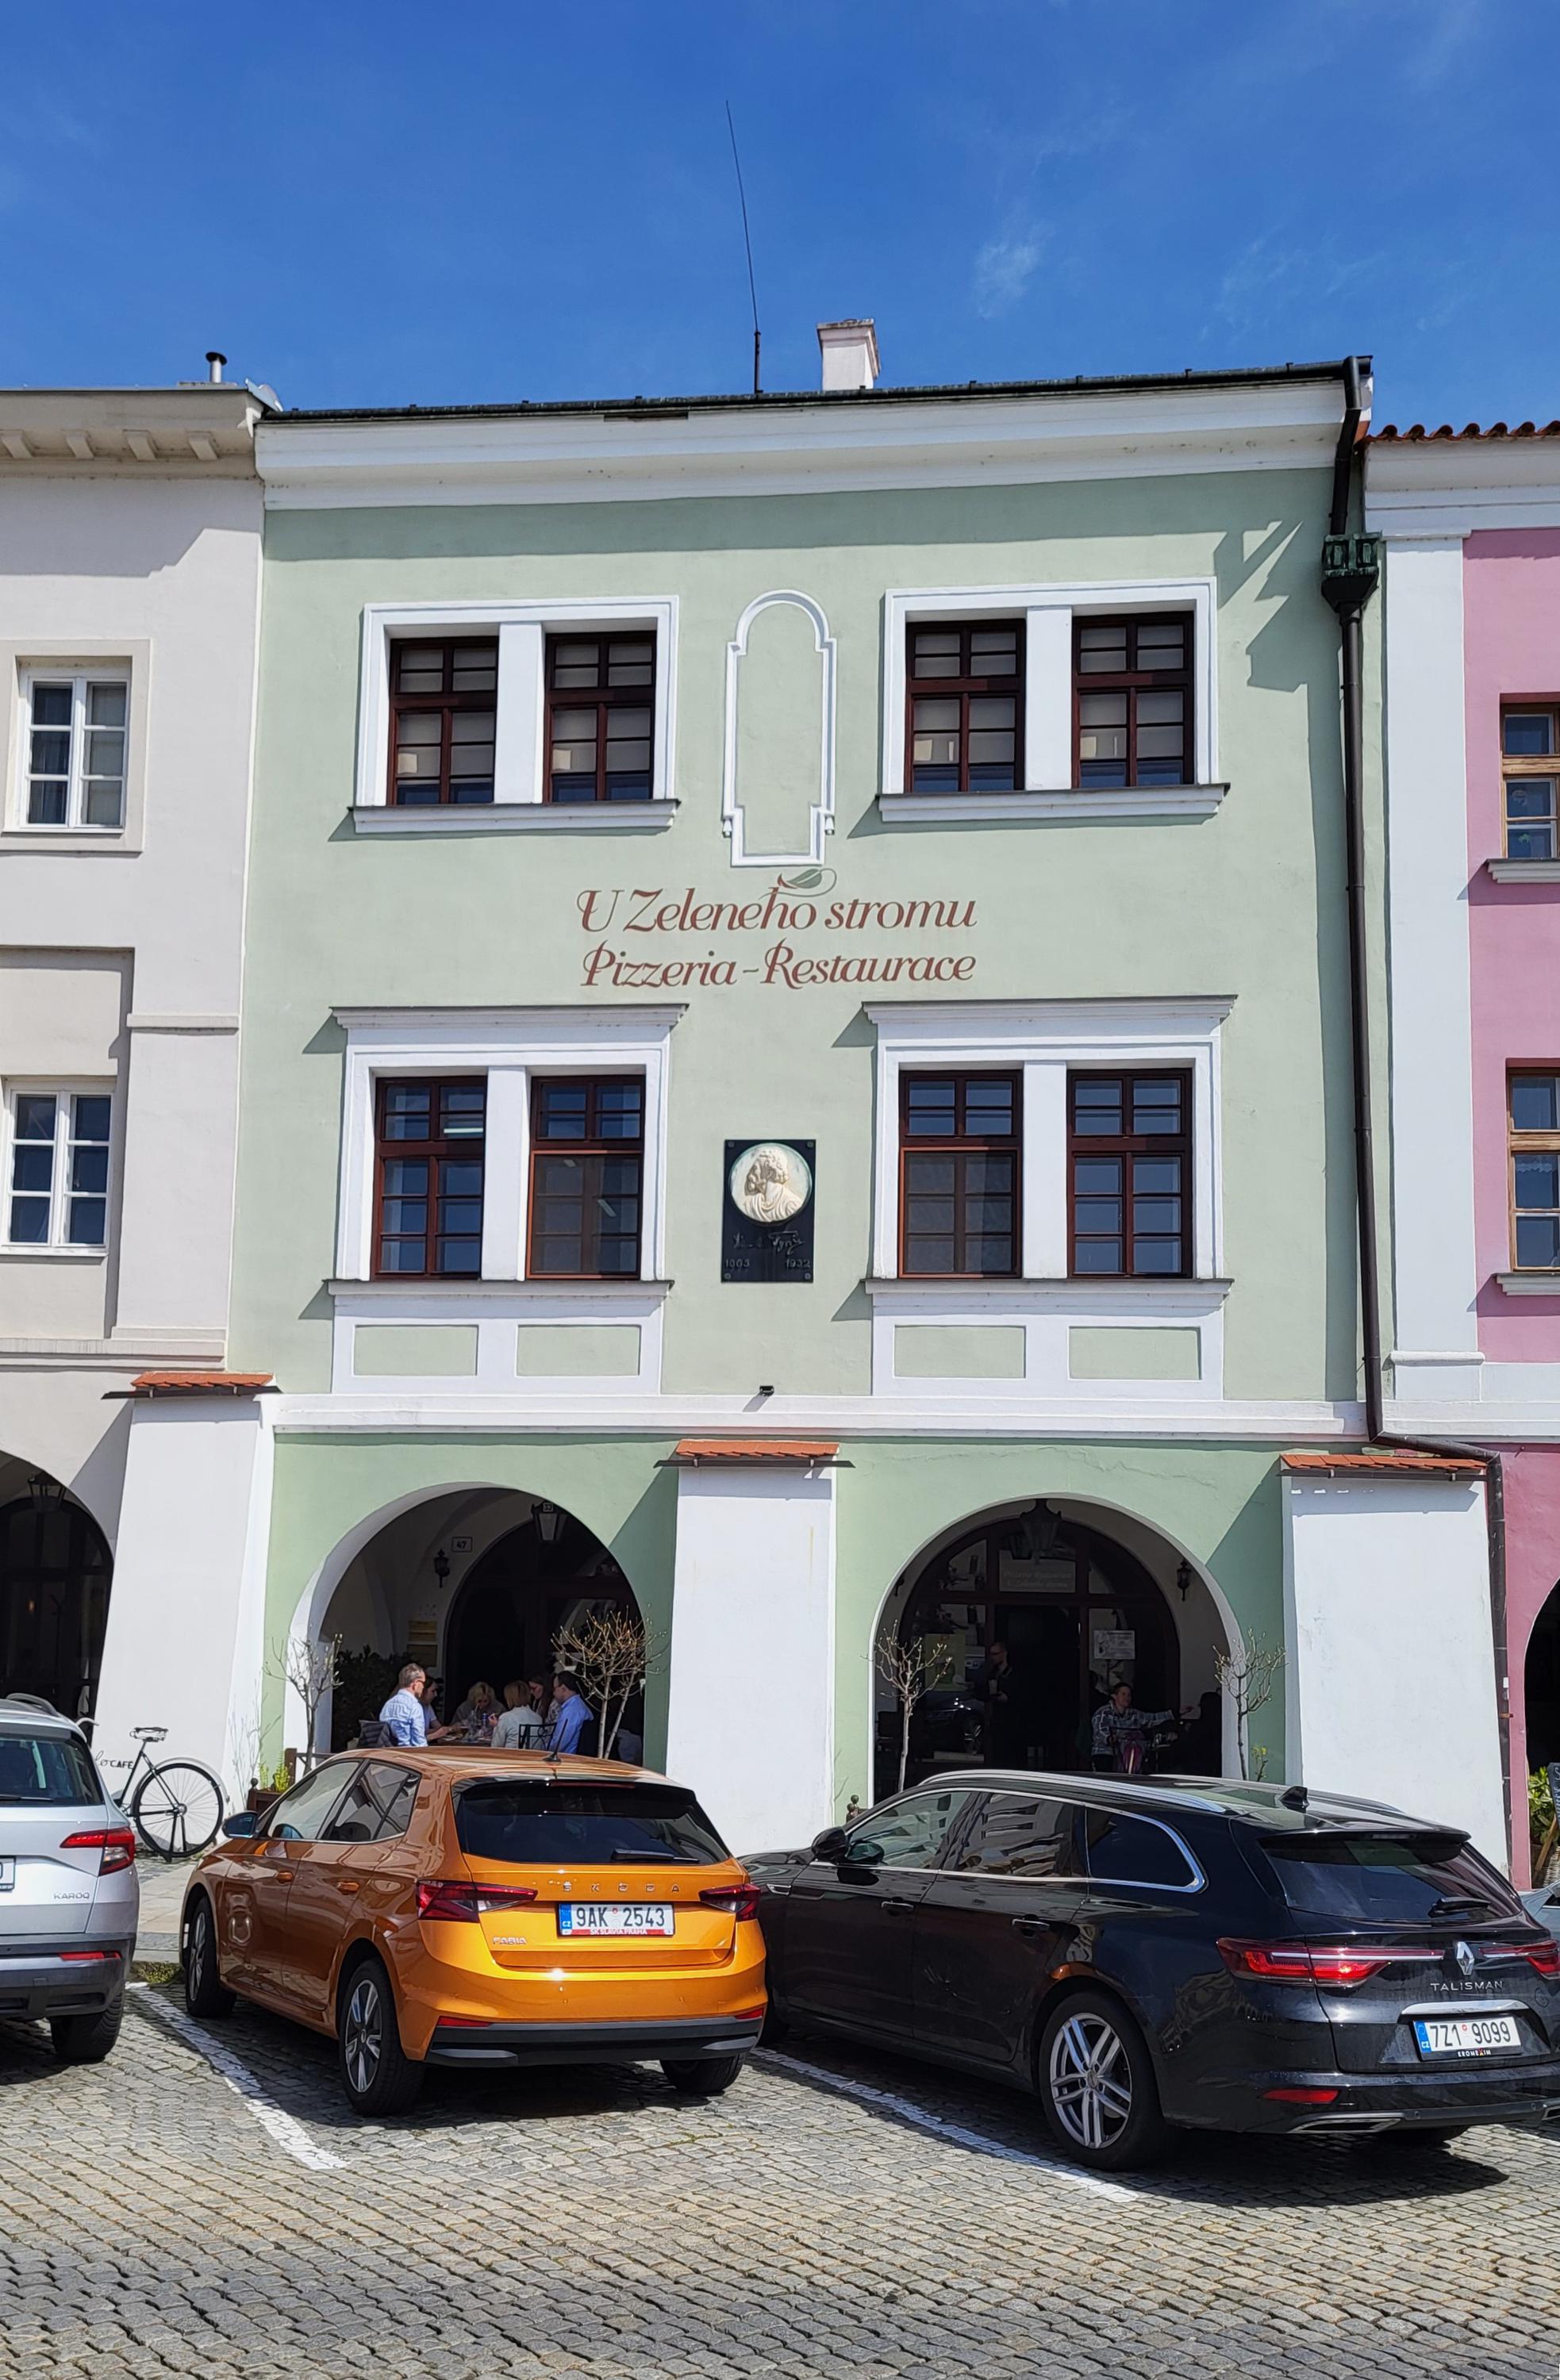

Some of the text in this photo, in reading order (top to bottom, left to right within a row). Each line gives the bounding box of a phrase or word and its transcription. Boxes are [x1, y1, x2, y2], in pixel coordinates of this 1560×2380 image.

[576, 889, 624, 932] U
[824, 897, 978, 931] stromu
[456, 1540, 467, 1549] 47
[576, 1906, 665, 1928] 9AK 2543
[493, 1937, 527, 1945] FABIA
[1430, 1980, 1503, 1992] TALISMAN
[1430, 2021, 1512, 2048] 7Z1 9099
